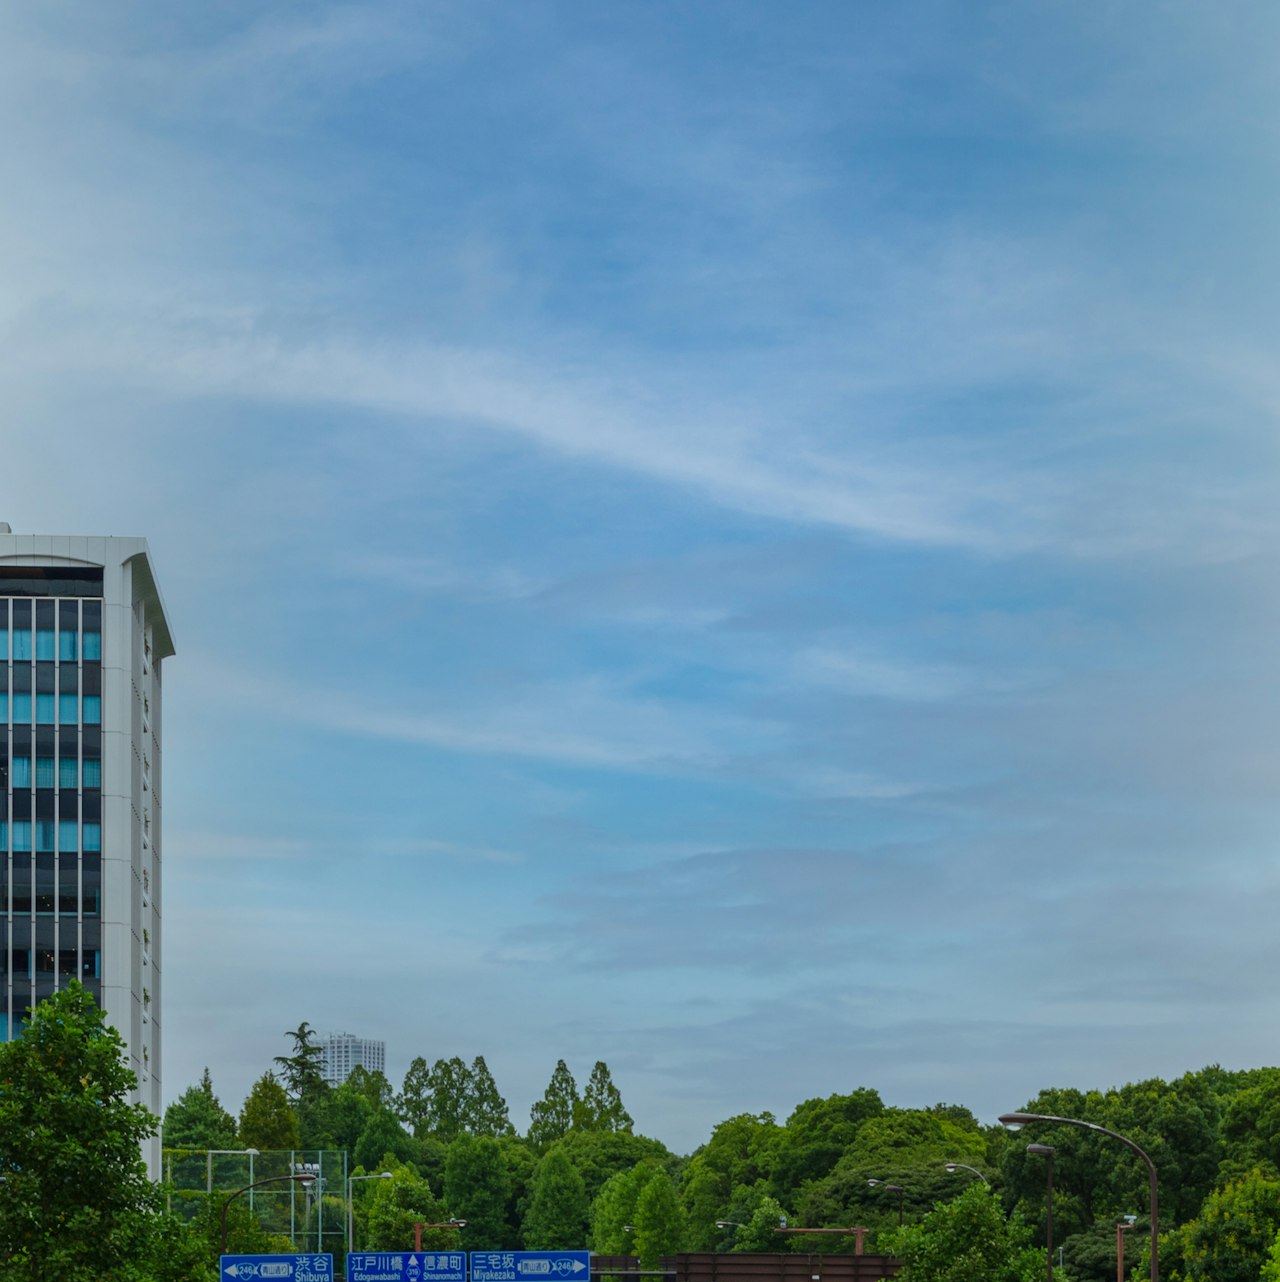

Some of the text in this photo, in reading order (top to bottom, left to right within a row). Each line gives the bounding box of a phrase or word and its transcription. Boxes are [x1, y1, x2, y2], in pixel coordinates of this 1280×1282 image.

[295, 1256, 329, 1271] 渋谷
[352, 1256, 403, 1270] 江戸川橋
[424, 1255, 462, 1270] 信濃町
[474, 1254, 515, 1269] 三宅坂
[557, 1262, 571, 1270] 246
[239, 1266, 253, 1274] 246
[423, 1272, 463, 1280] Shinanomachi
[473, 1270, 515, 1282] Miyakezaka
[354, 1273, 401, 1282] Edogawabashi
